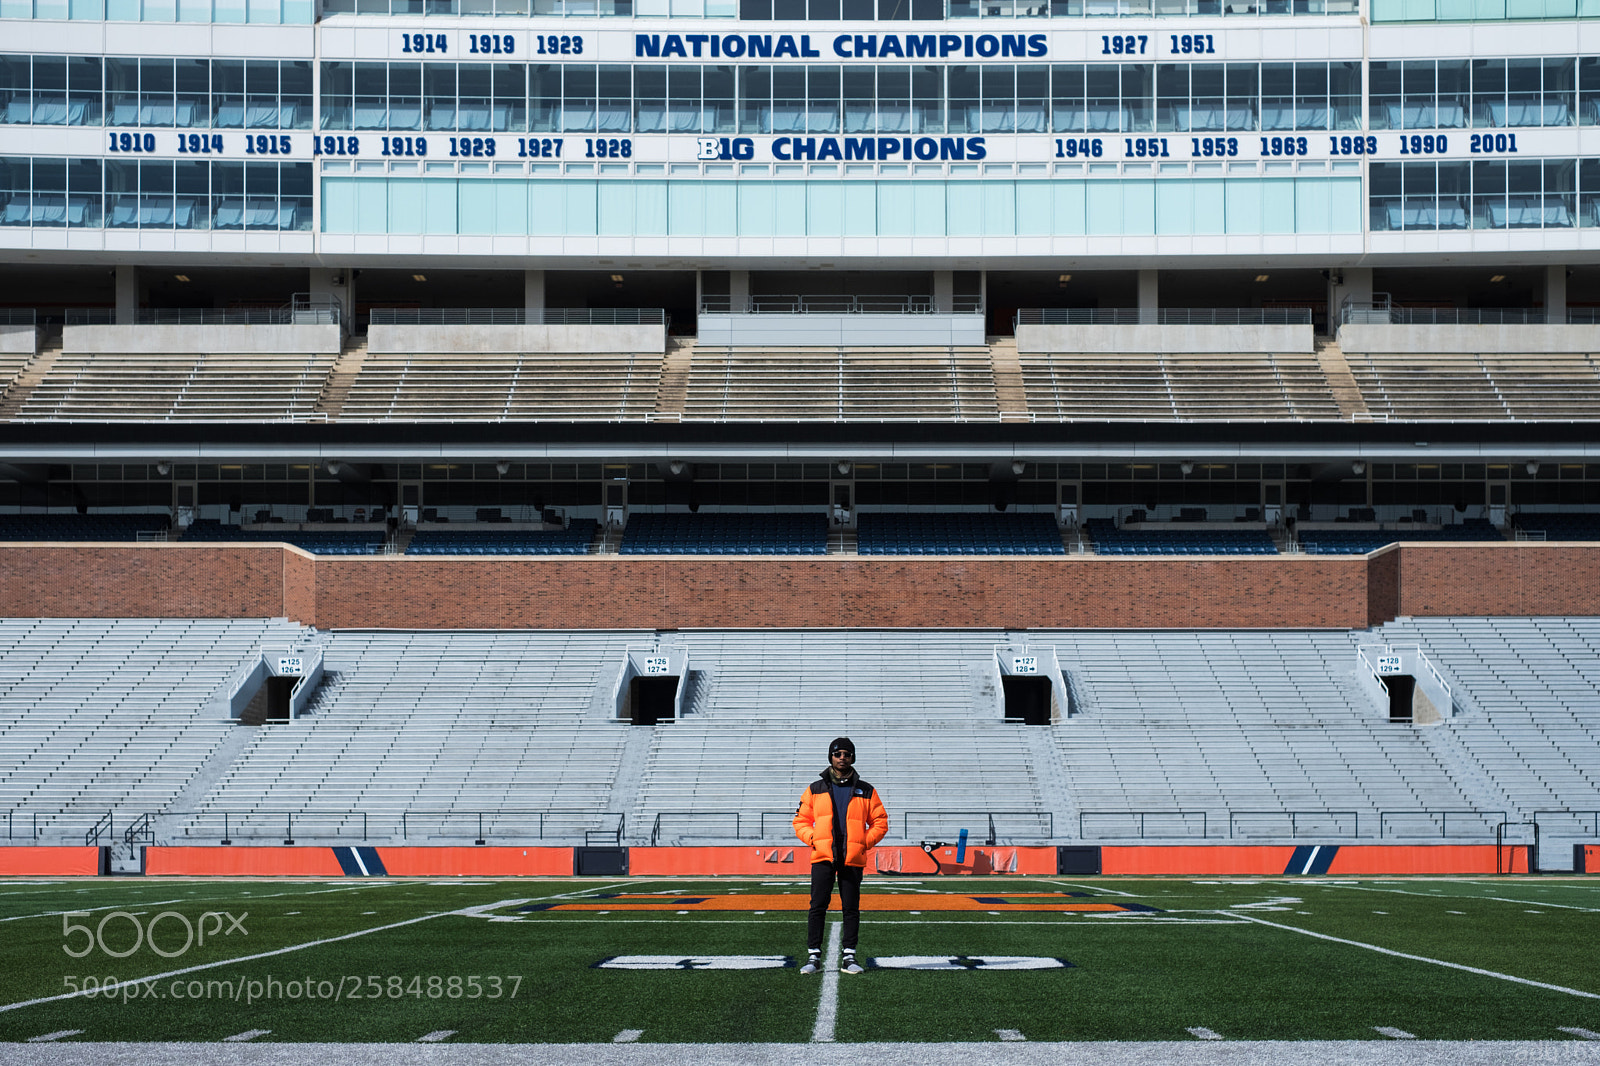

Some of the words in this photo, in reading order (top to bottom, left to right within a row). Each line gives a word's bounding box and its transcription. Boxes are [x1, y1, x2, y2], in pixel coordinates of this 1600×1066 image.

[403, 34, 447, 52] 1914
[470, 35, 514, 53] 1919
[537, 36, 582, 54] 1923
[636, 35, 819, 57] NATIONAL
[833, 35, 1047, 57] CHAMPIONS
[1102, 36, 1147, 54] 1927
[1171, 35, 1214, 53] 1951
[109, 133, 155, 152] 1910
[178, 134, 223, 153] 1914
[246, 135, 291, 153] 1915
[314, 136, 358, 155] 1918
[382, 137, 426, 155] 1919
[450, 138, 495, 156] 1923
[519, 139, 563, 157] 1927
[586, 139, 631, 157] 1928
[772, 137, 986, 160] CHAMPIONS
[1056, 139, 1102, 157] 1946
[1126, 139, 1169, 157] 1951
[1192, 138, 1237, 156] 1953
[1261, 137, 1307, 155] 1963
[1330, 136, 1377, 154] 1983
[1400, 135, 1447, 154] 1990
[1471, 134, 1517, 152] 2001
